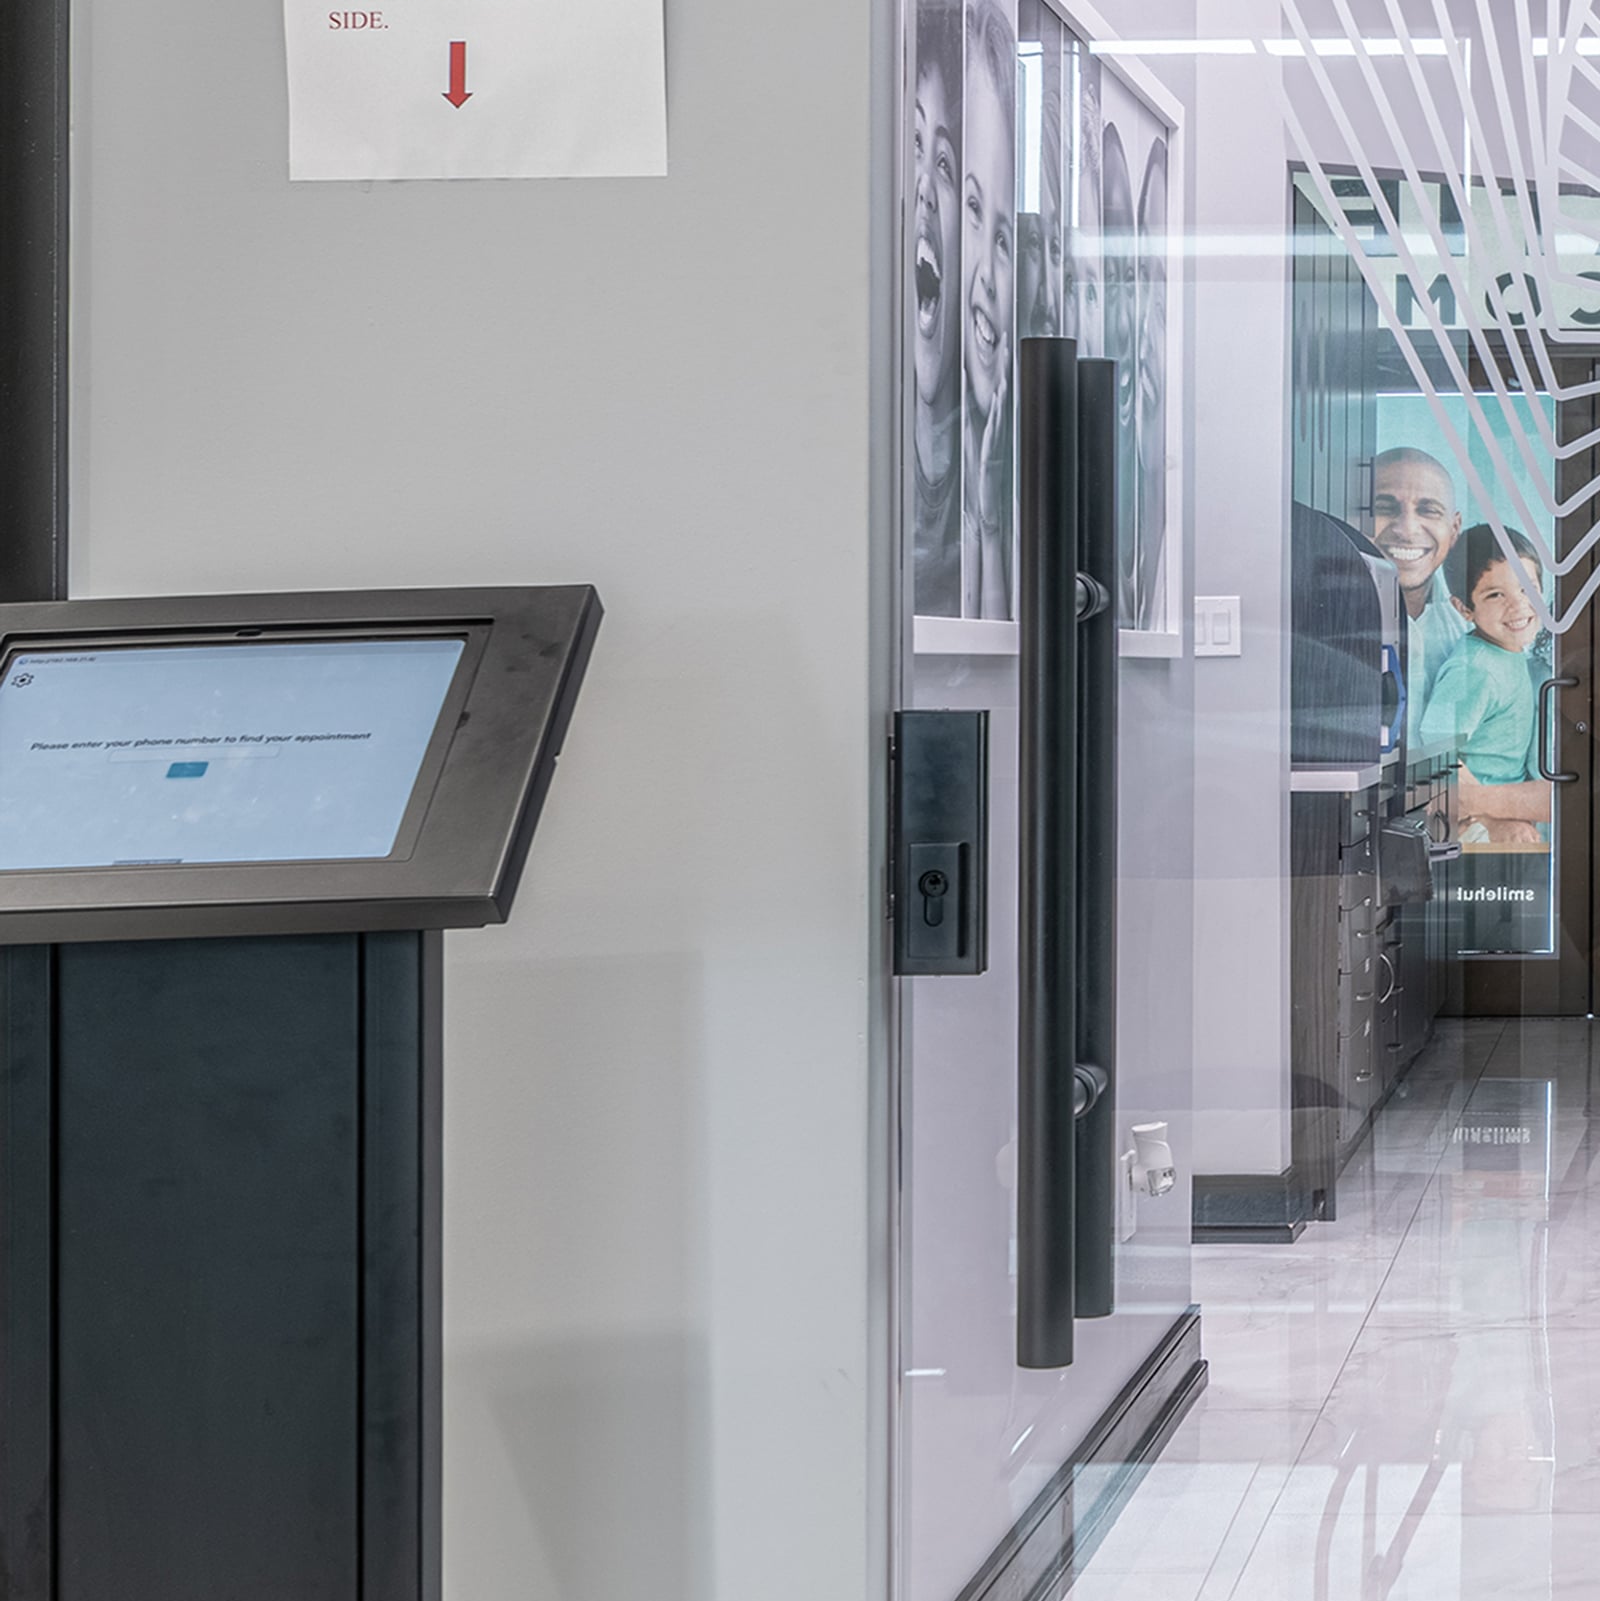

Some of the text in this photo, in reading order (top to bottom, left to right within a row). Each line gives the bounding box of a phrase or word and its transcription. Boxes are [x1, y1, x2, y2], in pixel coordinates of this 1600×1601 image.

[328, 10, 390, 32] SIDE.
[30, 732, 373, 751] Please enter your phone number to find your appointment
